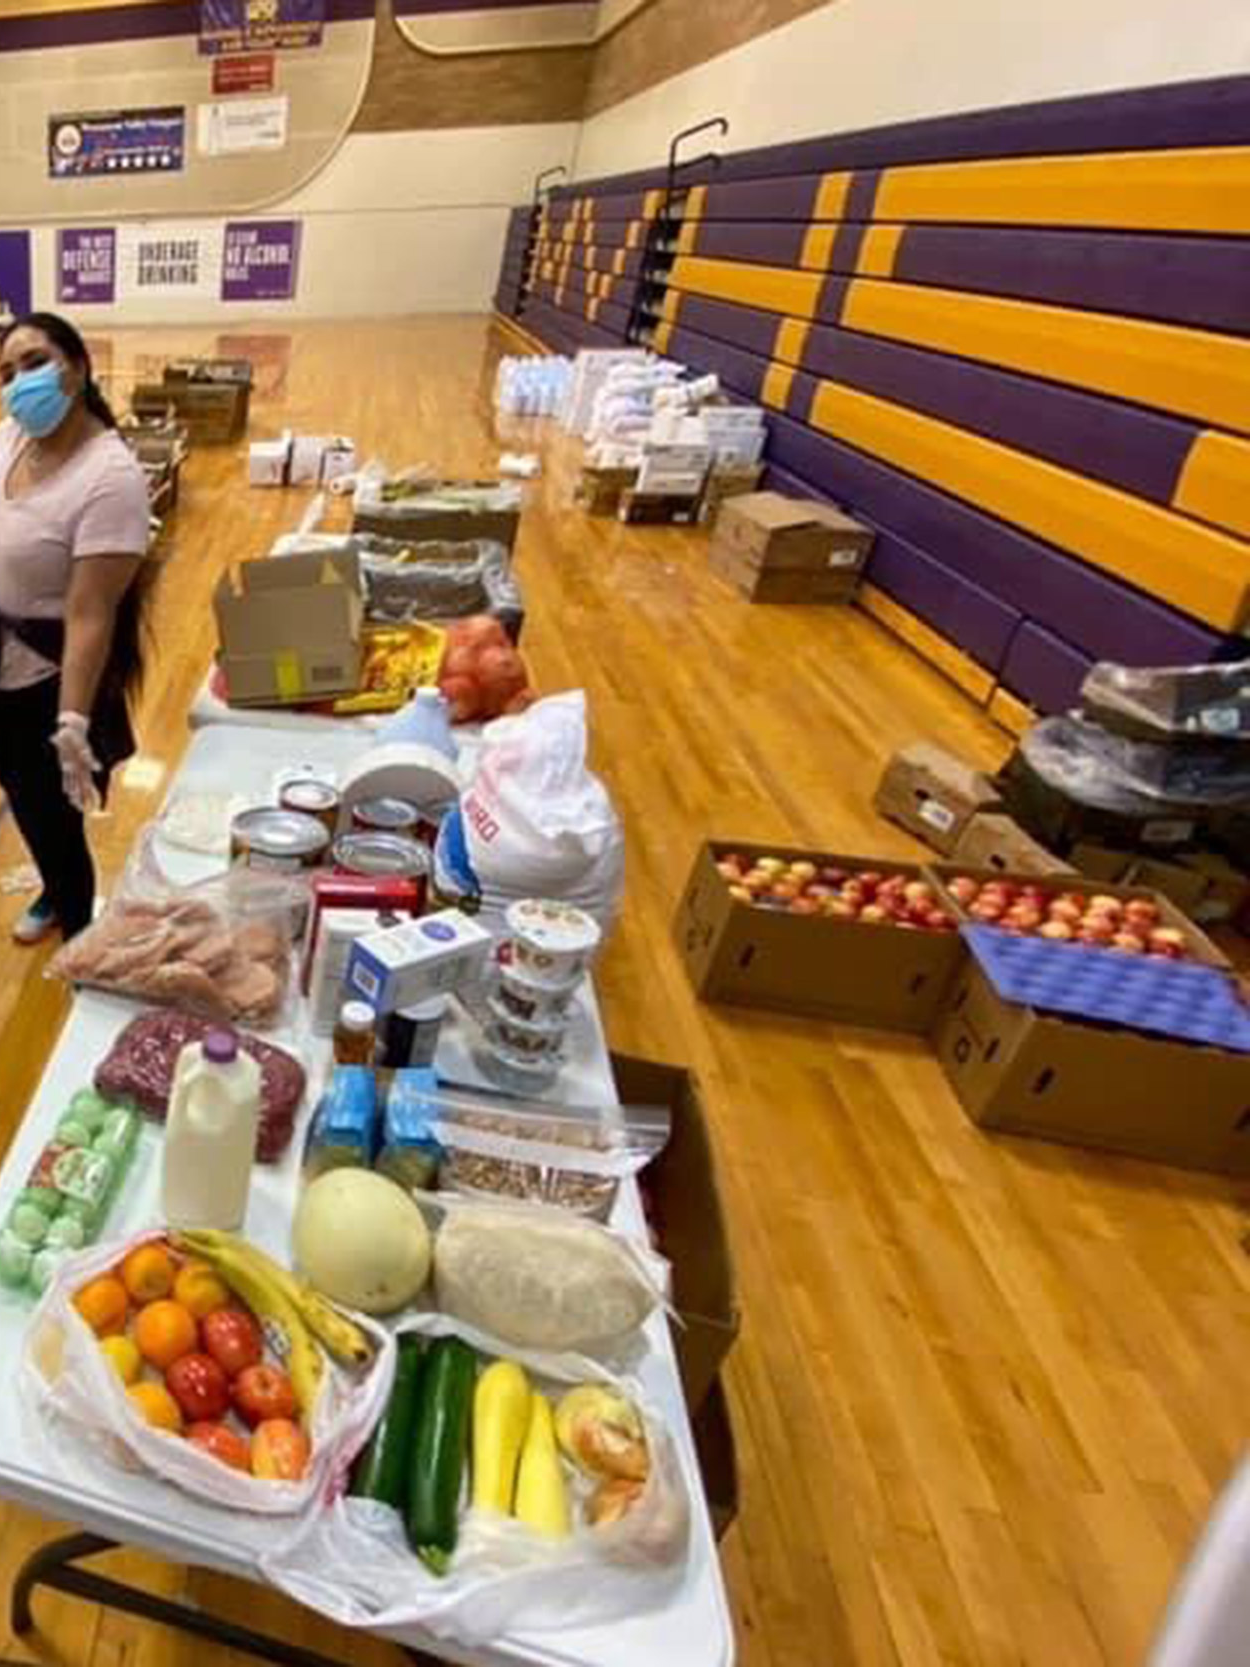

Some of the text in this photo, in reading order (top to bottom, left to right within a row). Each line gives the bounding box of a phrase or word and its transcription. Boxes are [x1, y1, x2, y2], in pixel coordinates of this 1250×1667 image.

[63, 250, 112, 270] DEFENSE
[138, 241, 198, 261] UNDERAGE
[137, 264, 197, 286] DRINKING
